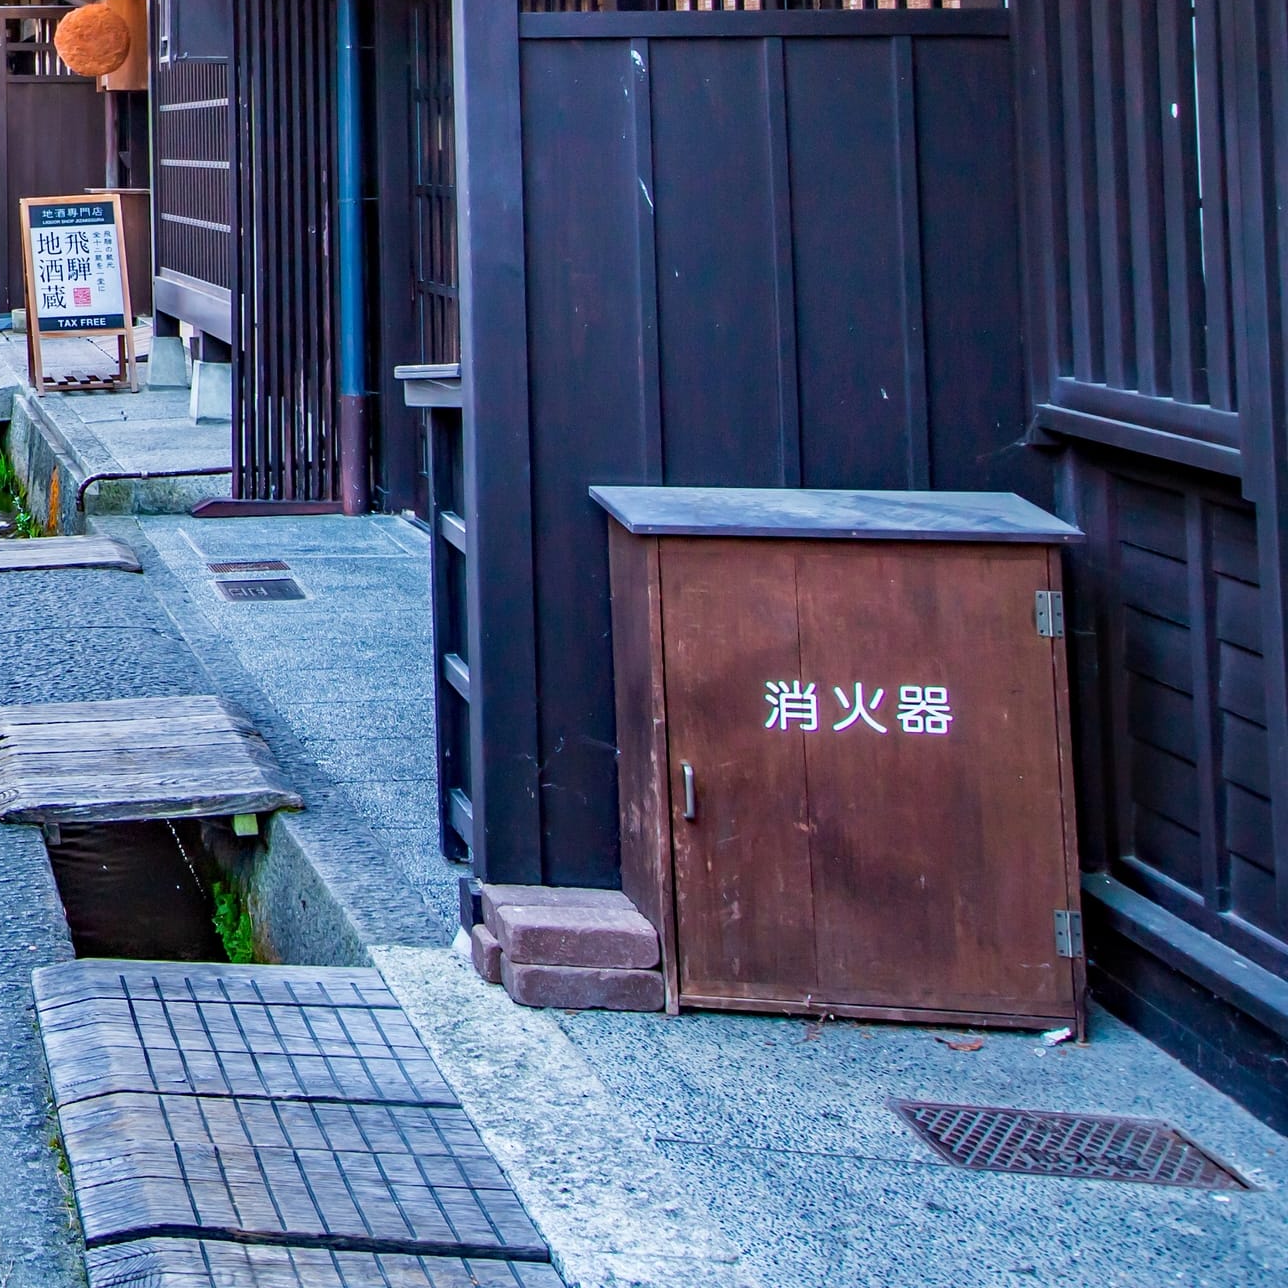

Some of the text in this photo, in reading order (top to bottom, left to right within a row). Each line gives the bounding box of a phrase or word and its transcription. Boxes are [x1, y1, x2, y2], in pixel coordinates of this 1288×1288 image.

[37, 232, 66, 309] 地酒蔵
[58, 317, 106, 328] TAX FREE
[765, 680, 953, 734] 消火器
